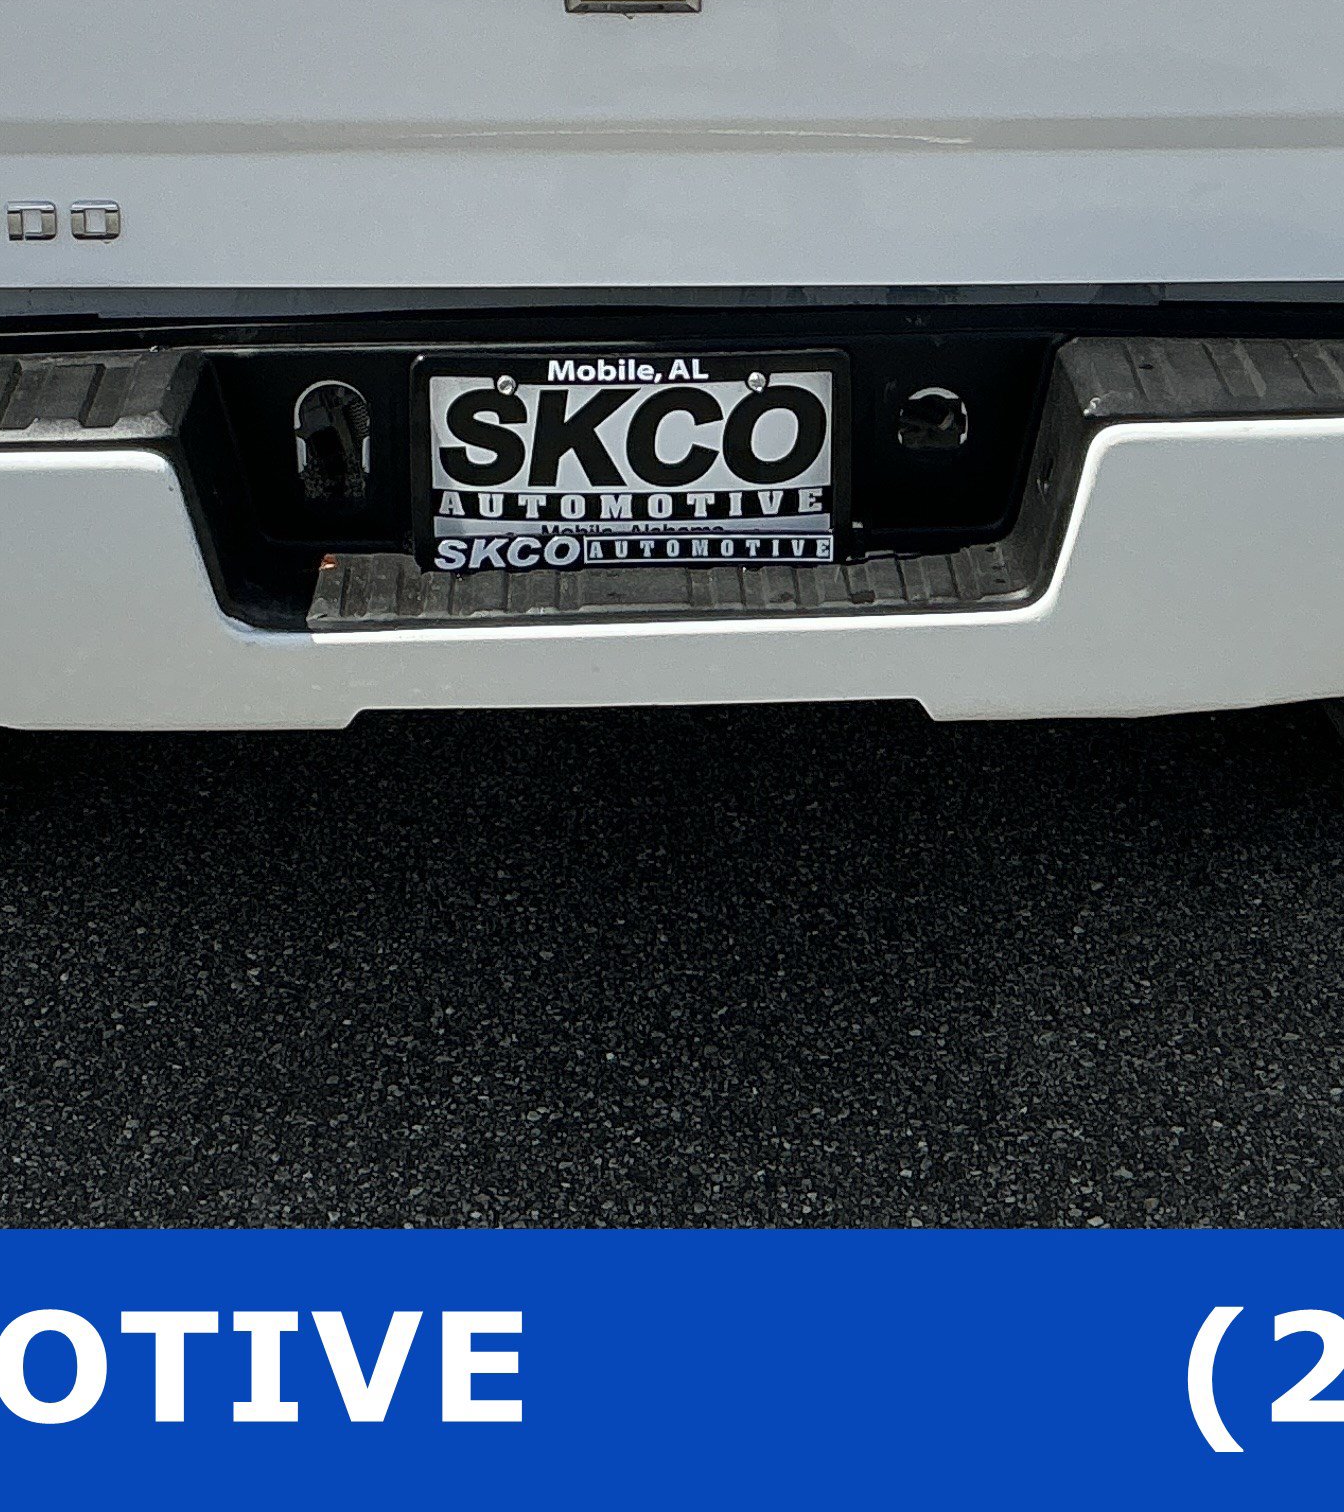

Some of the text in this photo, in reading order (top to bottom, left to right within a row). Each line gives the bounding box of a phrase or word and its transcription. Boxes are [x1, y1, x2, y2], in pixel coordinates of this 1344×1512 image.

[547, 358, 709, 385] Mobile, AL
[438, 385, 828, 487] SKCO
[439, 488, 824, 519] AUTOMOTIVE
[434, 535, 831, 570] SKCO AUTOMOTIVE
